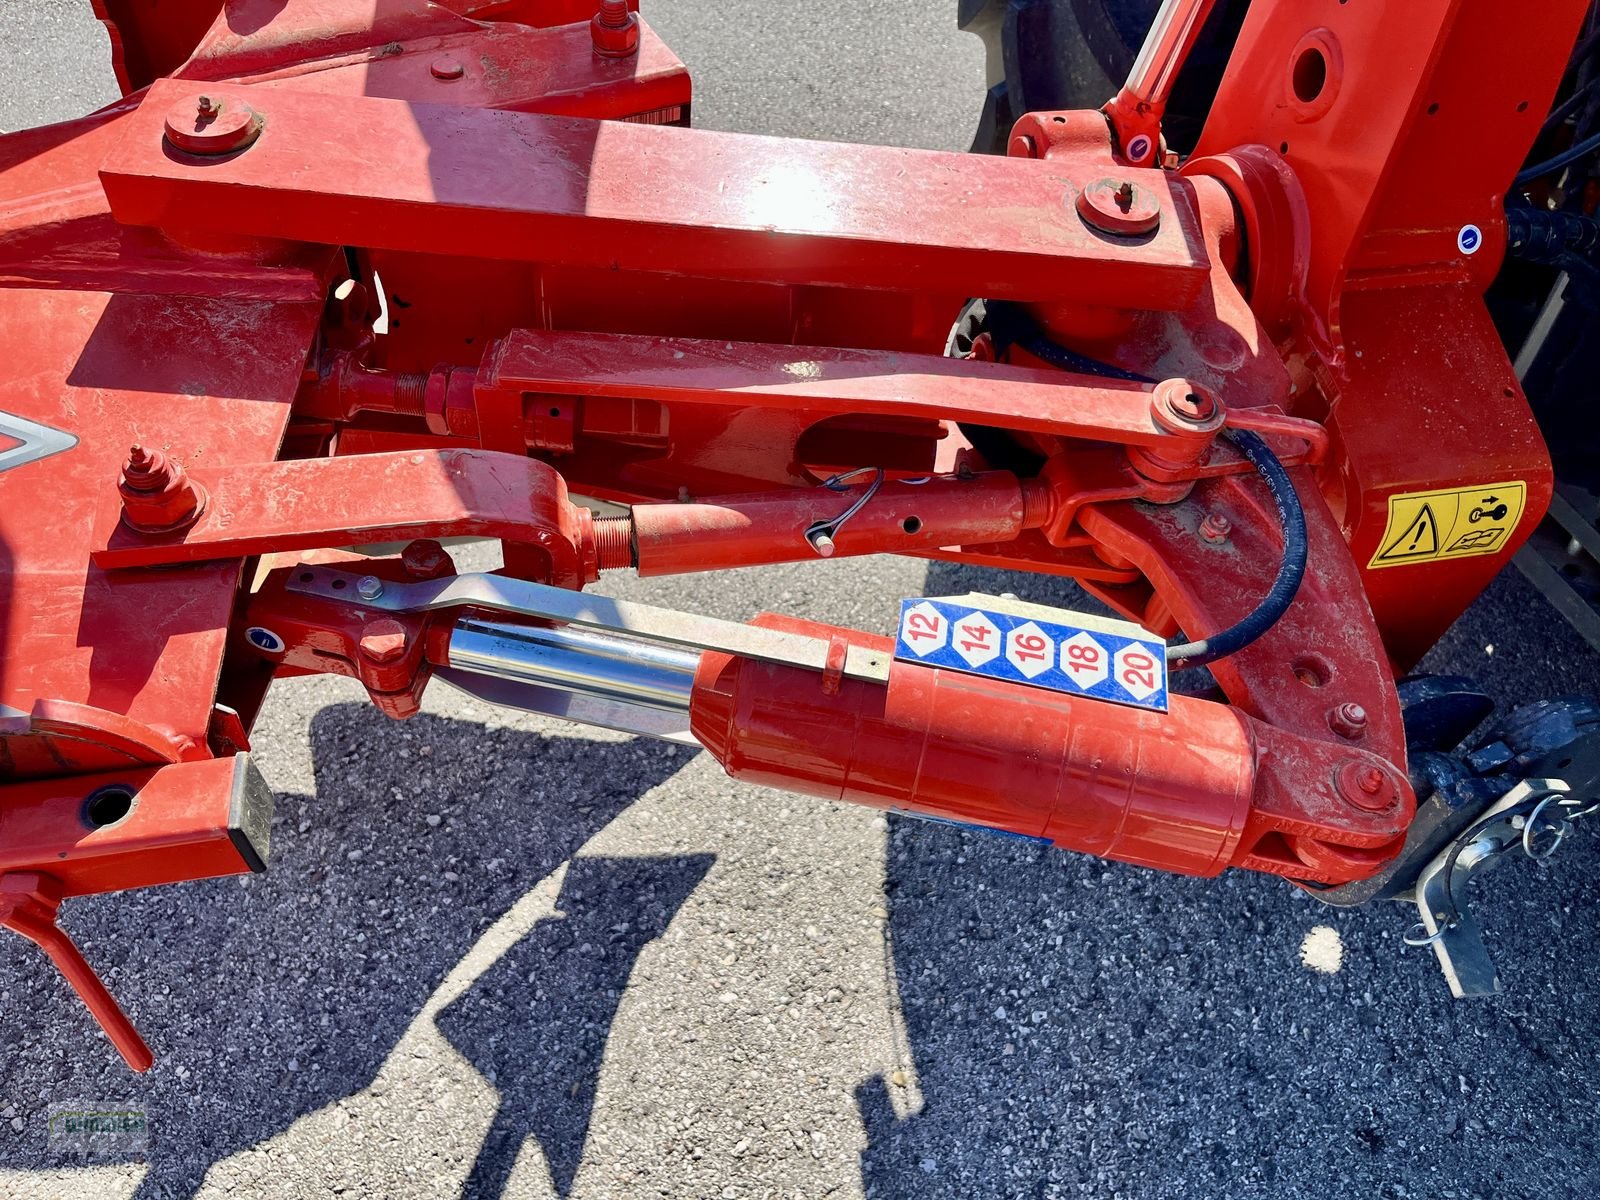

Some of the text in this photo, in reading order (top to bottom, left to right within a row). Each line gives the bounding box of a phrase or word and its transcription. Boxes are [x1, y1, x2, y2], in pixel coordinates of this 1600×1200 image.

[908, 613, 940, 642] 12
[960, 624, 992, 652] 14
[1014, 633, 1046, 663] 16
[1068, 644, 1100, 673] 18
[1122, 652, 1154, 689] 20
